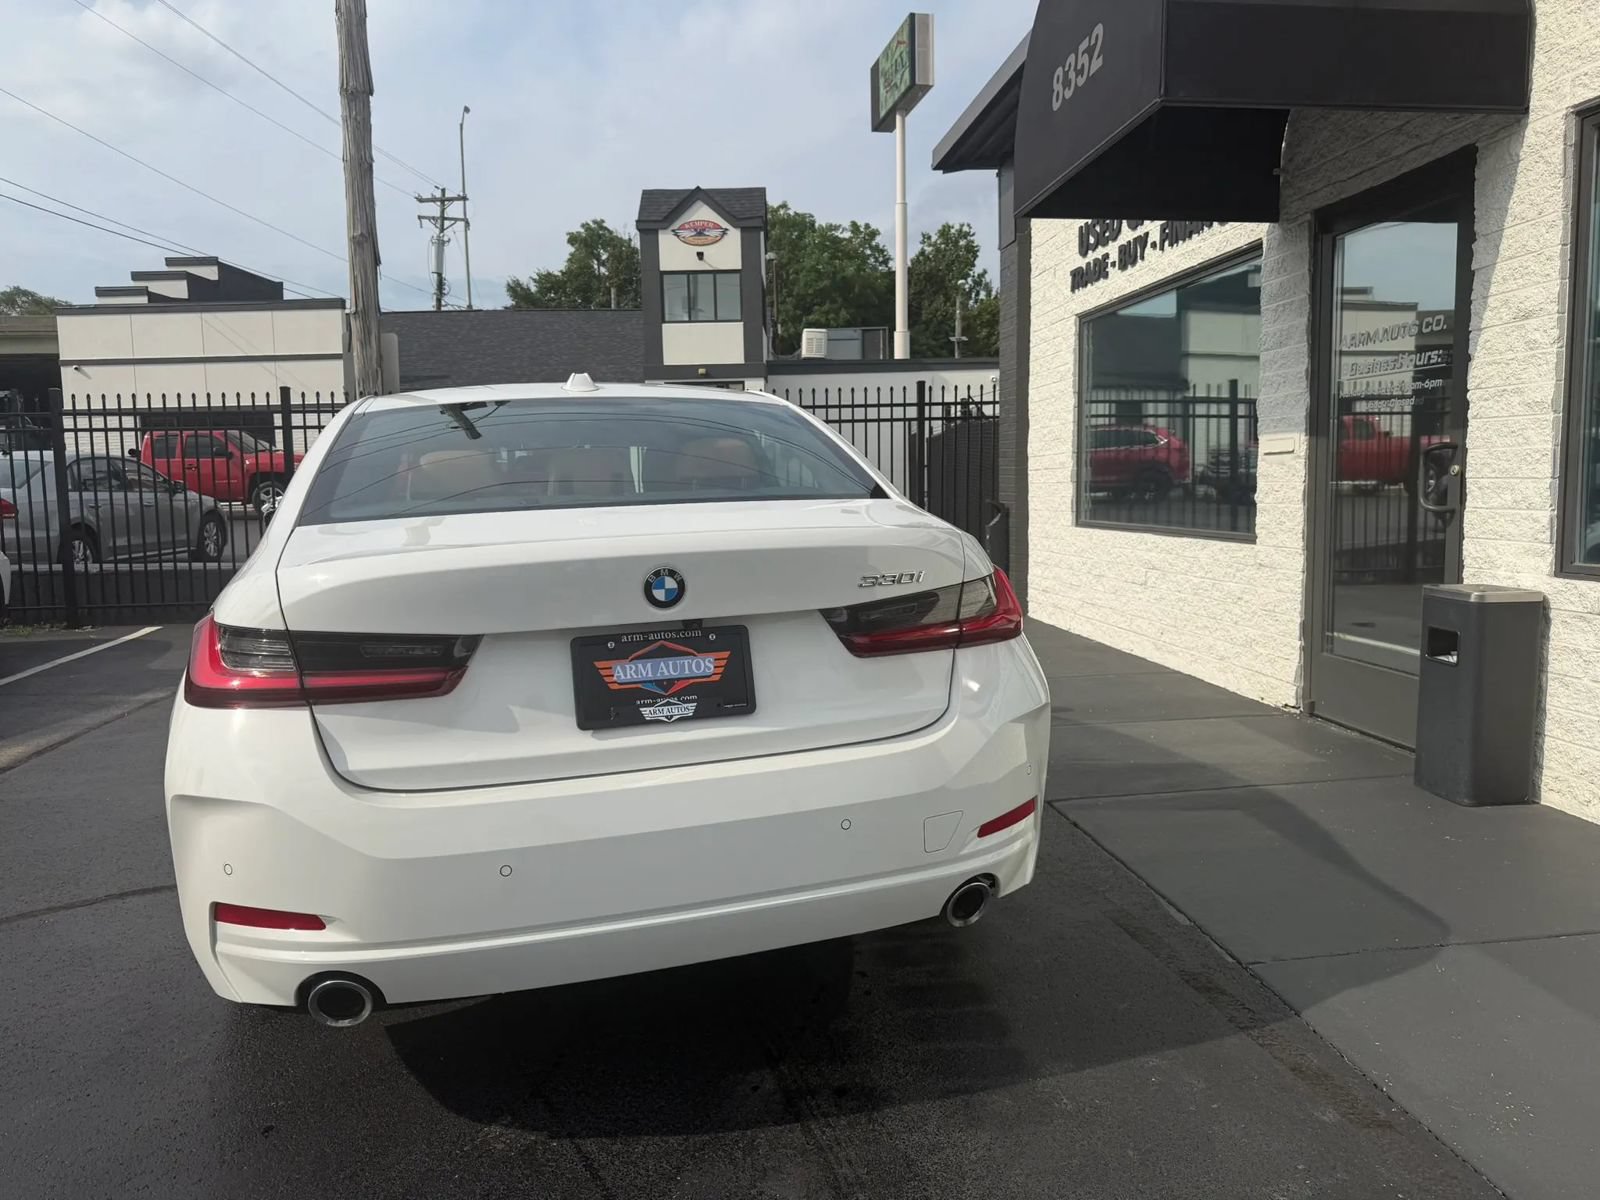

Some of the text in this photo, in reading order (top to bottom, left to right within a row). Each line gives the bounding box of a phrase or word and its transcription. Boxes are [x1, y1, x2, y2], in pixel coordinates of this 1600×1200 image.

[1052, 23, 1103, 111] 8352
[685, 221, 714, 229] KEMPER
[1078, 219, 1122, 257] USED
[1070, 252, 1109, 293] TRADE
[1118, 231, 1149, 271] BUY
[1159, 220, 1229, 251] FINA
[1421, 314, 1447, 334] CO.
[648, 568, 682, 582] BMW
[858, 571, 925, 587] 330i
[621, 629, 702, 642] arm-autos.com
[613, 657, 715, 680] ARM AUTOS
[649, 704, 690, 716] ARM AUTOS
